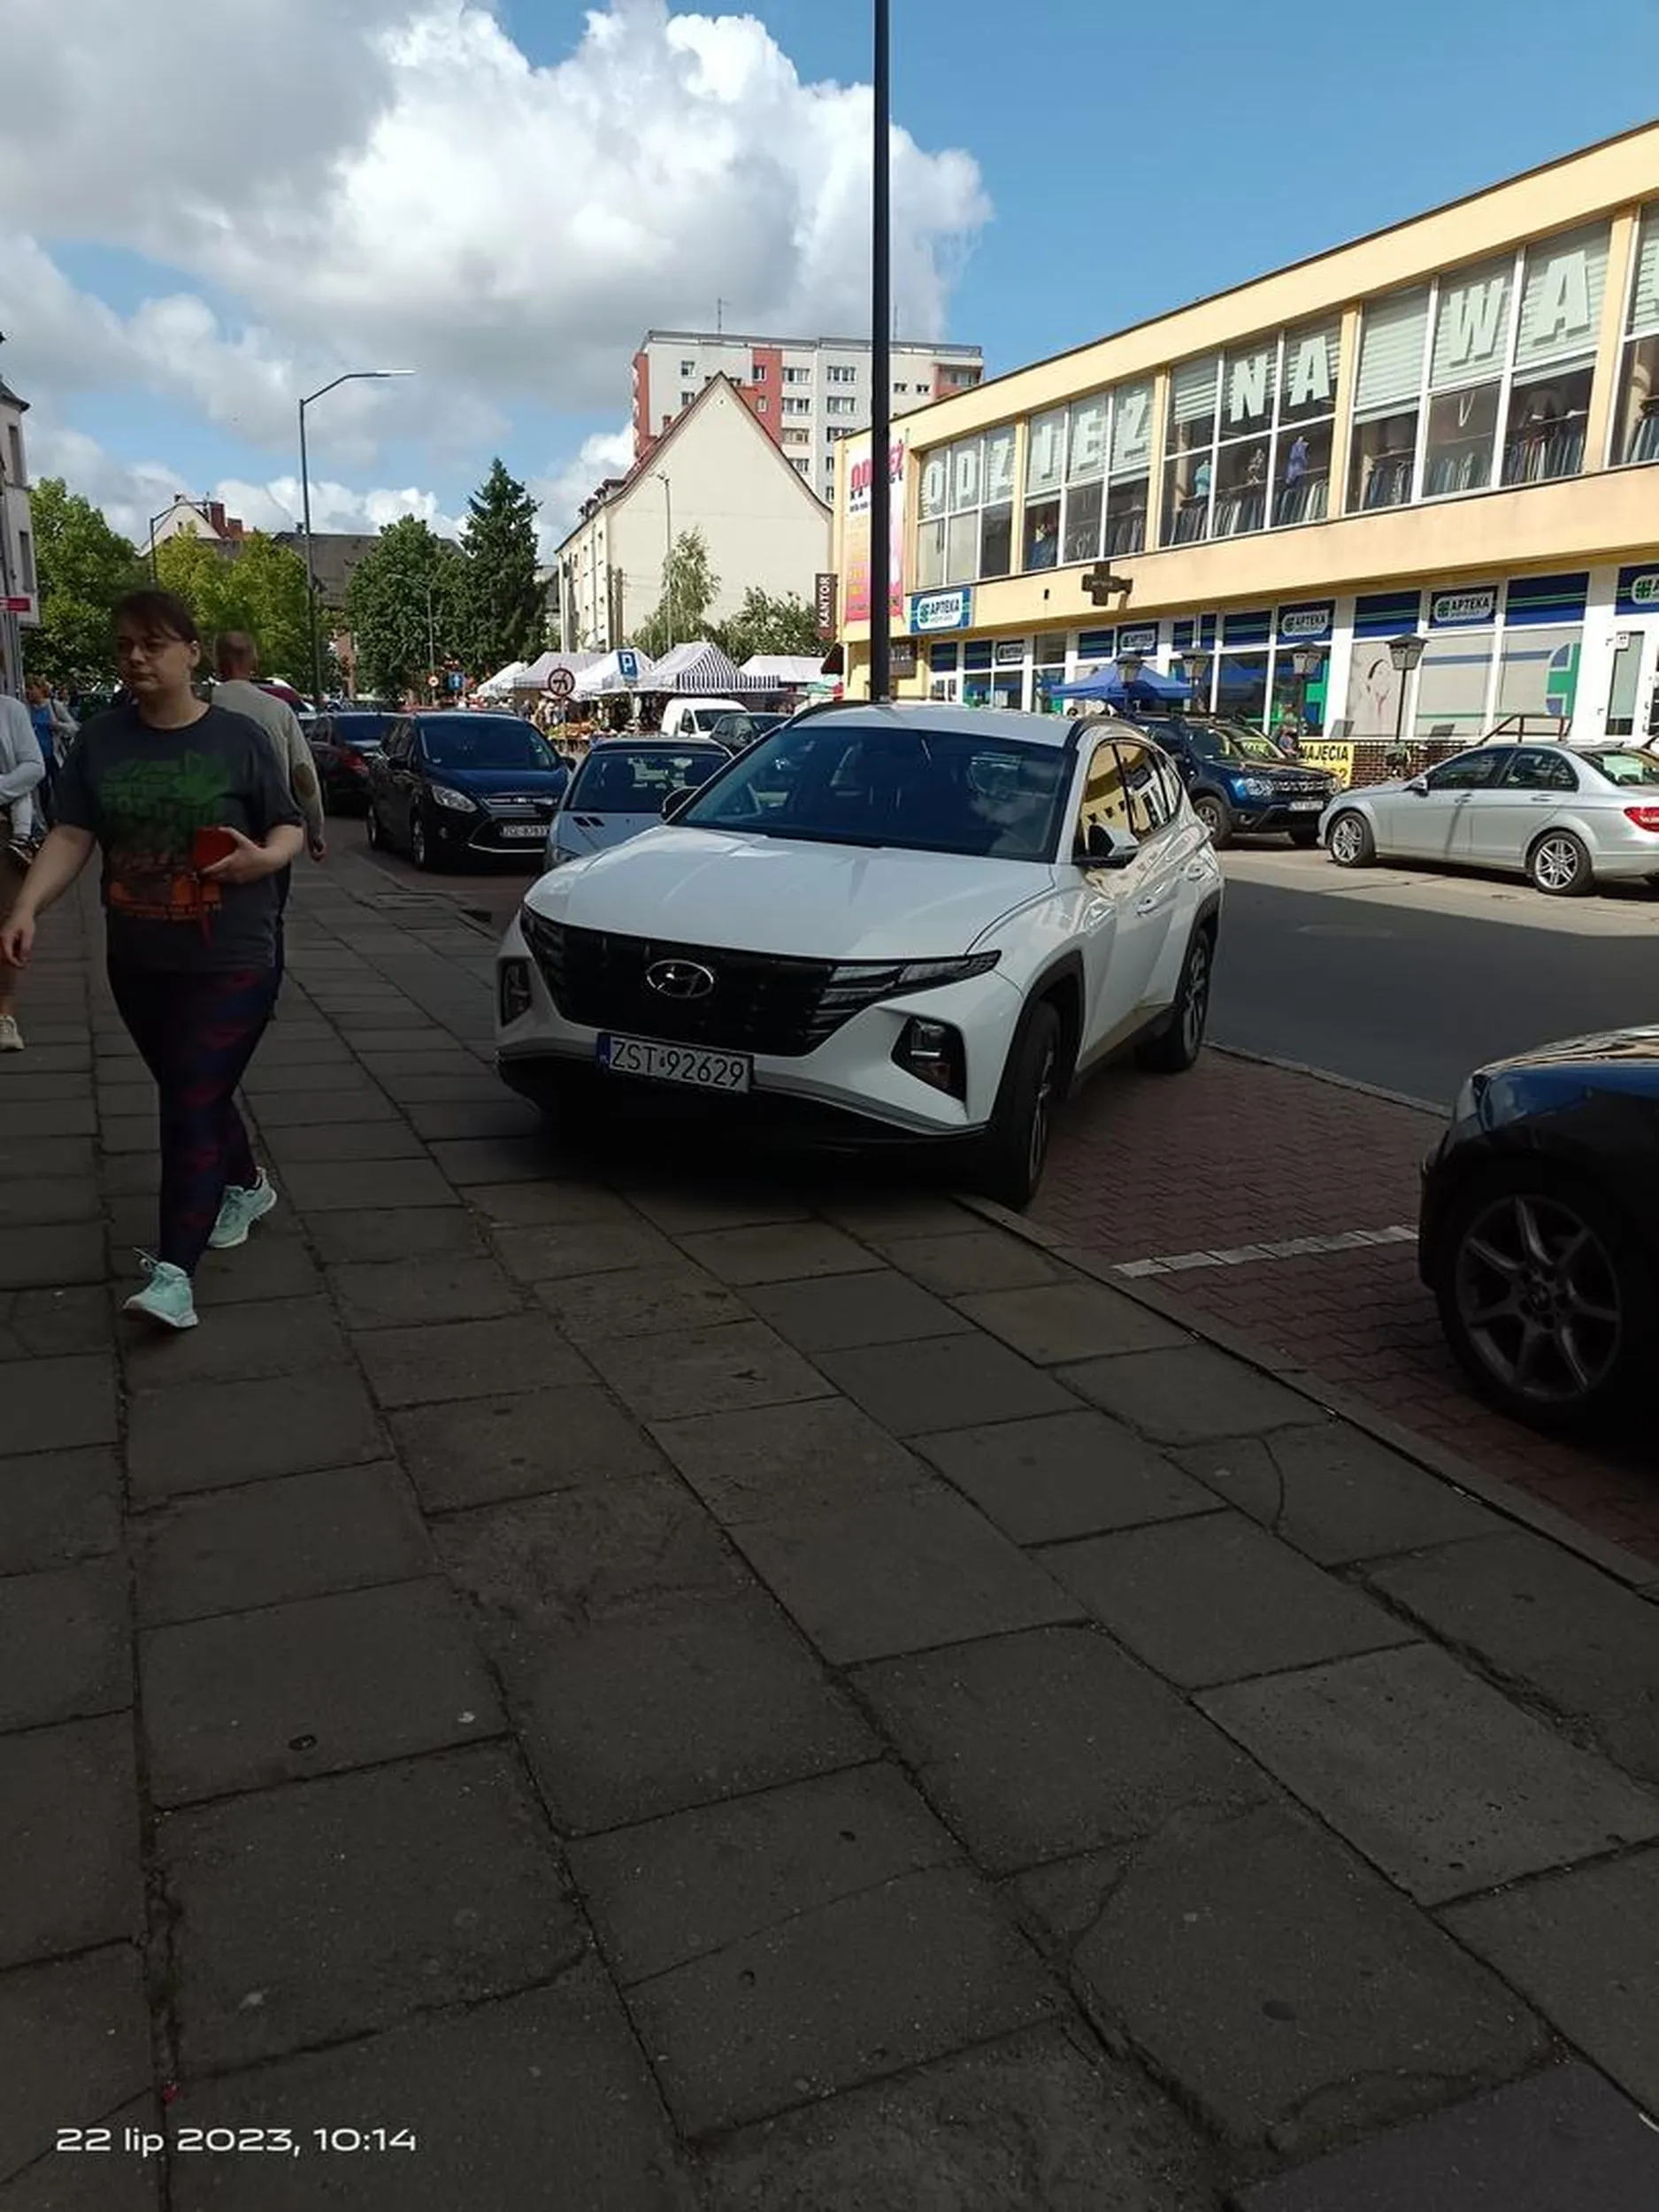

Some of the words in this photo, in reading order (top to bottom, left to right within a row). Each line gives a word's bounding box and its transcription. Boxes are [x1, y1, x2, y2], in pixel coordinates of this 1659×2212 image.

[1229, 334, 1331, 422] NA
[818, 576, 831, 627] KANTOR
[930, 598, 960, 615] APTEKA
[622, 655, 634, 672] P
[1299, 745, 1348, 764] NAJĘCIA
[611, 1040, 657, 1073] ZST
[667, 1049, 744, 1087] 92629
